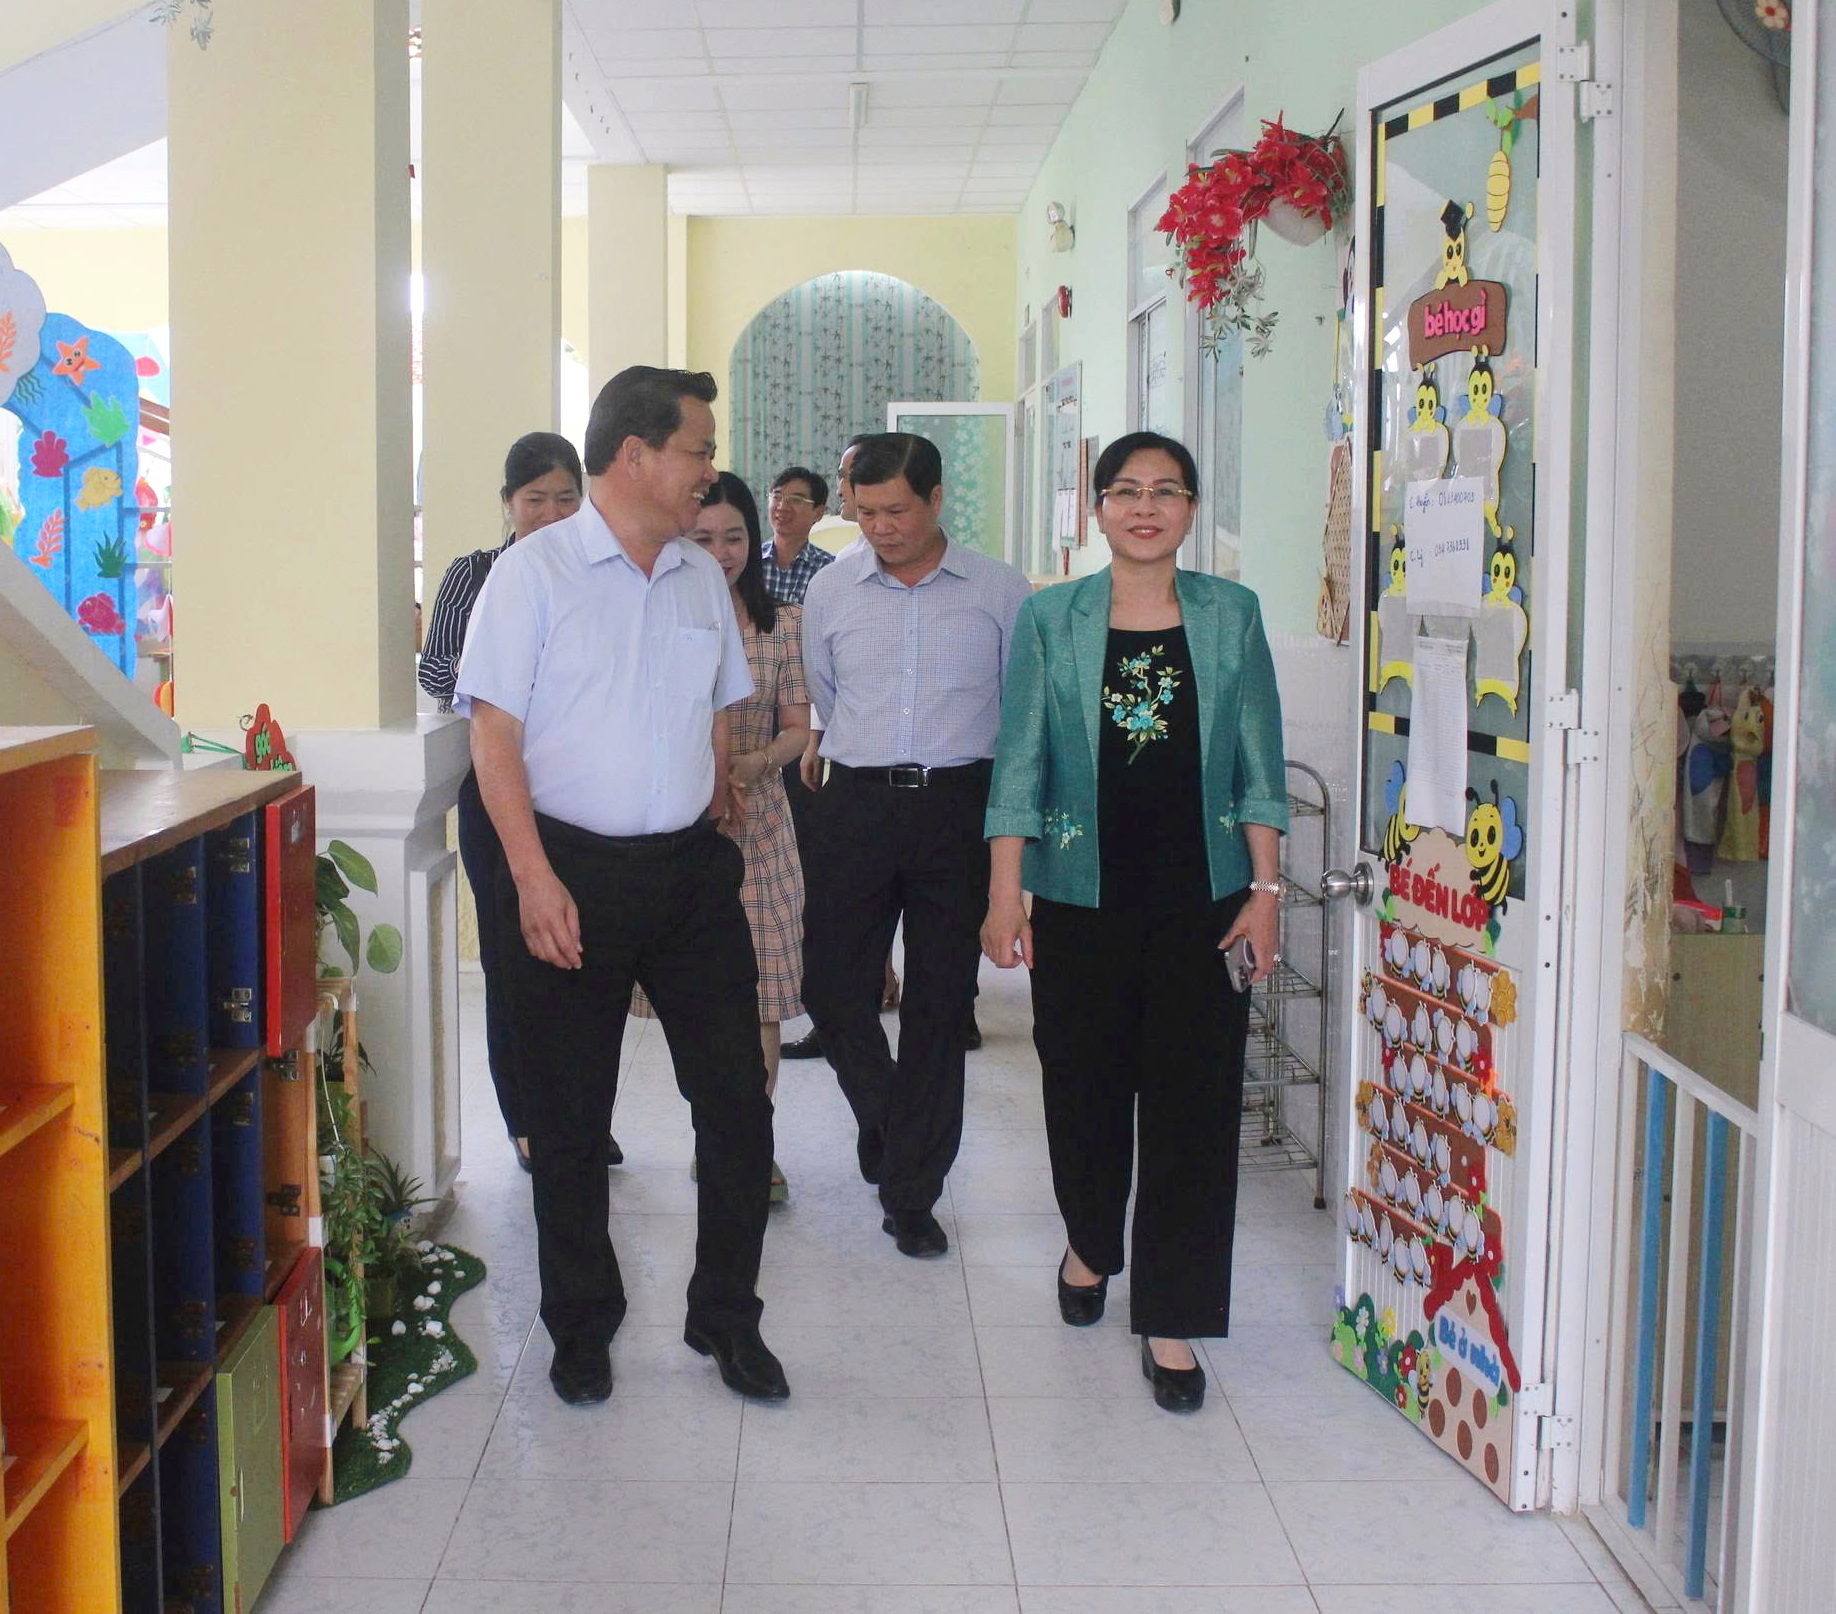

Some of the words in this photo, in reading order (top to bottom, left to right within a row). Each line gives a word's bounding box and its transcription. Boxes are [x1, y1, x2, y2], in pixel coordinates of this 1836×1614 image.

[1424, 302, 1443, 339] bé
[1443, 300, 1470, 340] học
[1470, 288, 1488, 336] gì
[1389, 857, 1412, 901] BÉ
[1412, 862, 1449, 919] ĐẾN
[1451, 883, 1489, 932] LỚP
[1439, 1315, 1456, 1350] Bé
